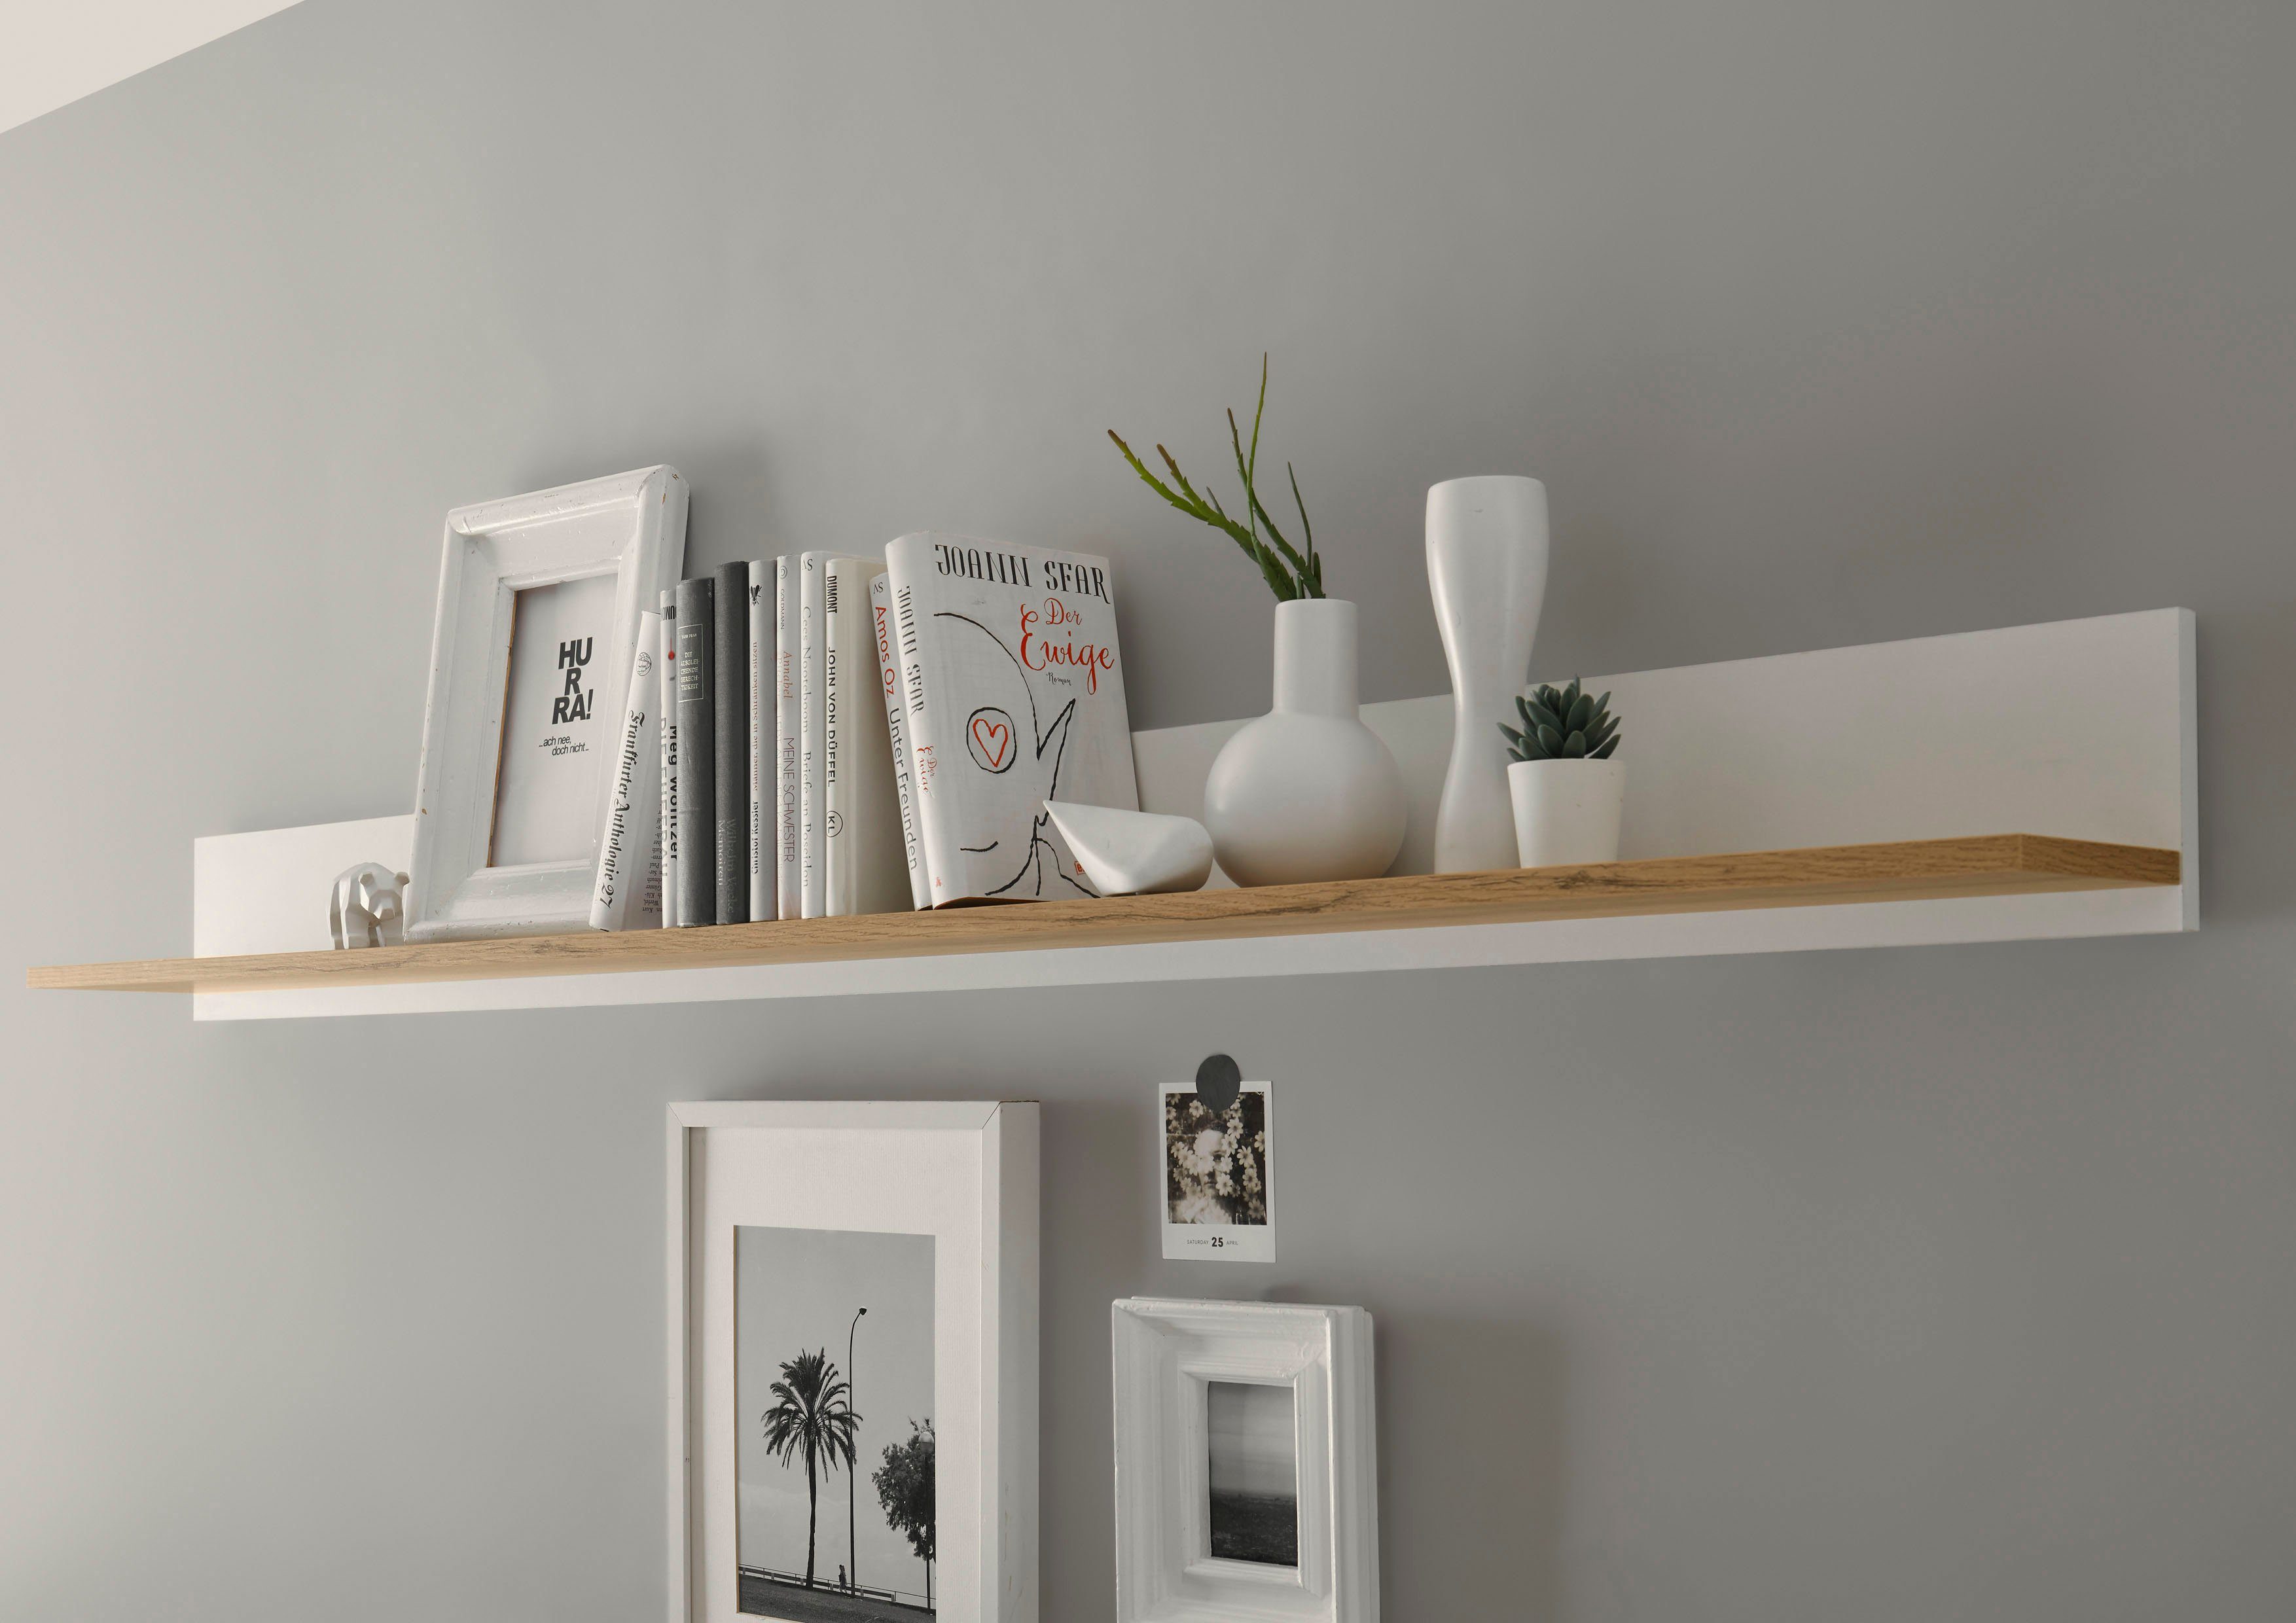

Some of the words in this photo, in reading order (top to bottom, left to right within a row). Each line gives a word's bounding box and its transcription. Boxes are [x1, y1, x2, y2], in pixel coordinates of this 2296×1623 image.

[935, 544, 1032, 587] JOANN
[1044, 561, 1111, 604] SFAR
[827, 575, 838, 613] DUMONT
[1044, 597, 1083, 626] Der
[802, 606, 811, 641] Cees
[875, 607, 889, 663] Amos
[897, 586, 917, 655] JOANN
[558, 637, 593, 669] HU
[1020, 604, 1115, 695] Ewige
[564, 668, 581, 696] R
[680, 683, 699, 691] TIGKEIT
[783, 651, 793, 699] Annabel
[802, 646, 812, 733] Nooteboom
[884, 668, 895, 699] Oz
[906, 664, 924, 717] SFAR
[1046, 672, 1071, 686] Roman
[552, 688, 594, 724] RA!
[558, 736, 571, 745] nee,
[752, 724, 758, 733] in
[889, 707, 904, 768] Unter
[552, 745, 568, 756] doch
[618, 709, 645, 798] Frankfurter
[783, 738, 795, 779] MEINE
[828, 730, 838, 787] DÜFFEL
[802, 751, 812, 793] Briefe
[783, 785, 795, 863] SCHWESTER
[802, 799, 808, 816] an
[827, 815, 835, 834] KL
[898, 772, 917, 870] Freunden
[604, 798, 630, 881] Anthologie
[802, 823, 812, 887] Poseidon
[600, 881, 615, 909] 27
[1211, 1237, 1224, 1247] 25
